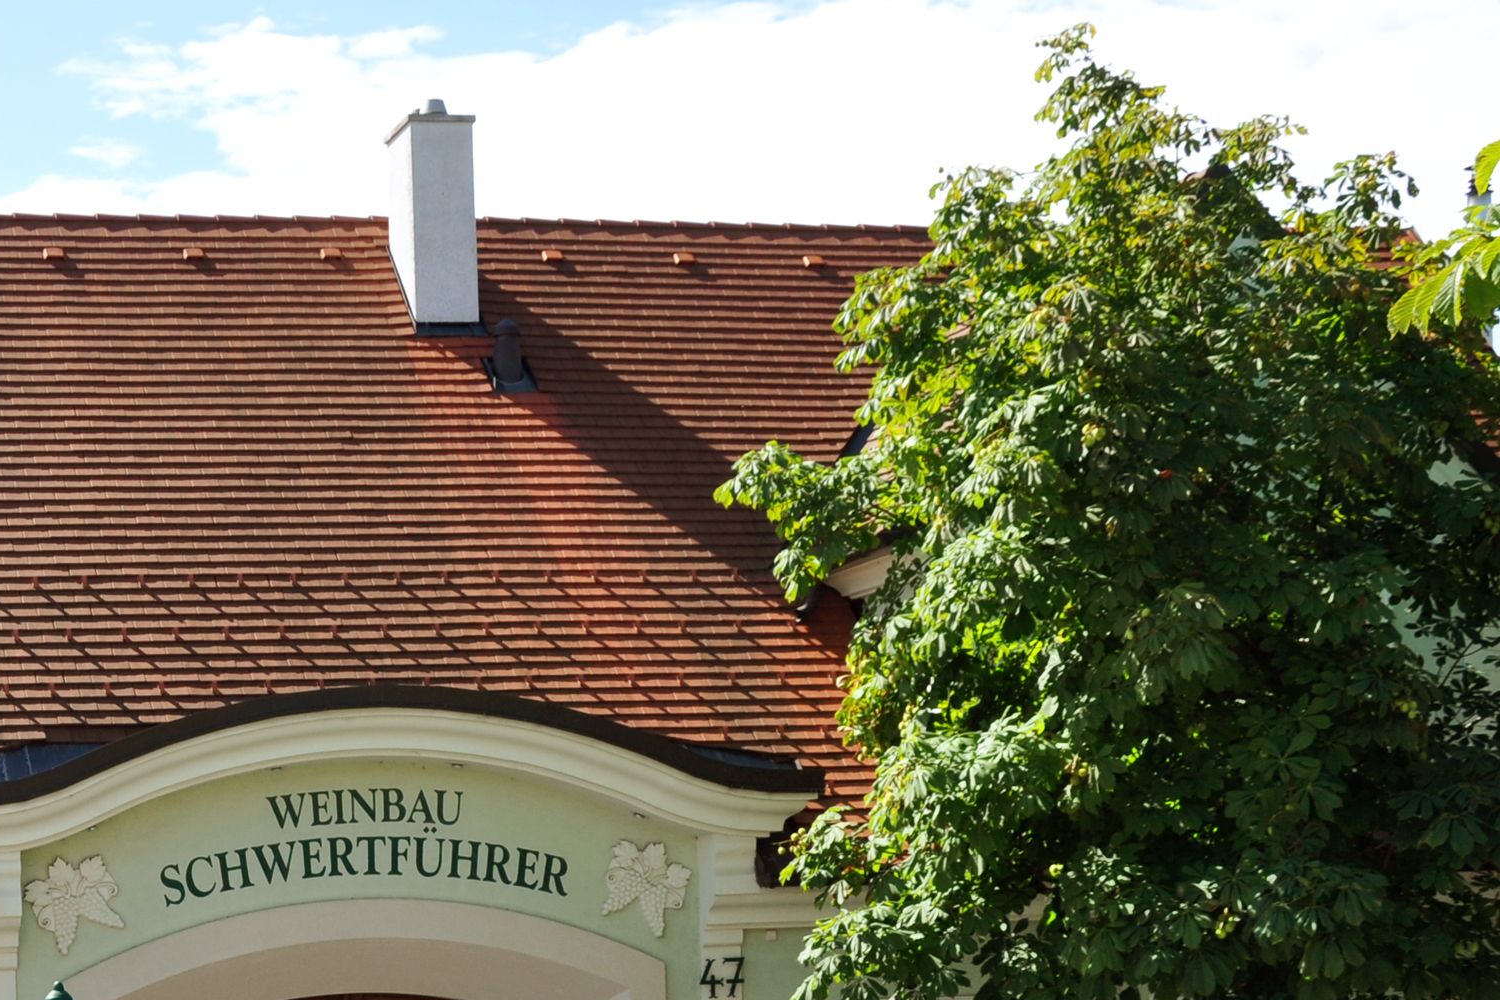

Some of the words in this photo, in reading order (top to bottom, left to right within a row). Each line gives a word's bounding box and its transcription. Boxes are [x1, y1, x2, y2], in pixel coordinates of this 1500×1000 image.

[266, 788, 463, 829] WEINBAU
[160, 828, 569, 906] SCHWERTFÜHRER
[699, 957, 745, 999] 47
